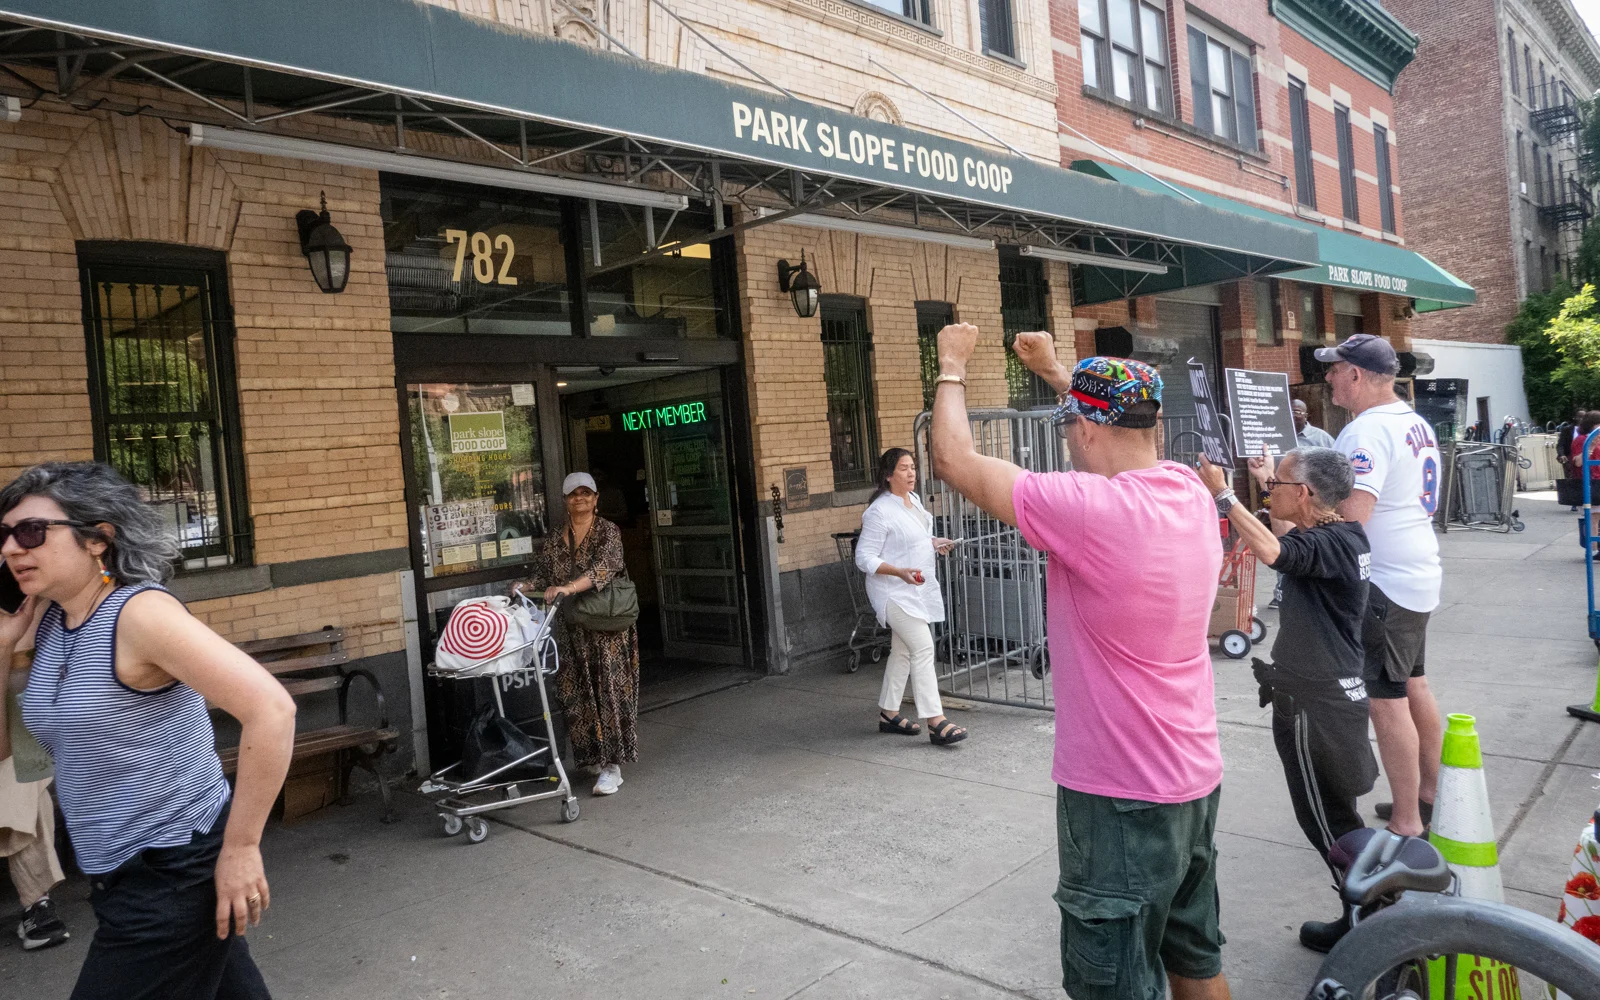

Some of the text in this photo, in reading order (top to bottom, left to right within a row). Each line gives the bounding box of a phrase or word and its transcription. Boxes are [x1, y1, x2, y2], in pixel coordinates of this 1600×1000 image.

[732, 102, 1013, 194] PARK SLOPE FOOD COOP
[446, 229, 518, 286] 782
[1328, 265, 1408, 292] PARK SLOPE FOOD COOP
[622, 409, 653, 431] NEXT
[655, 401, 707, 427] MEMBER
[452, 438, 504, 452] FOOD COOP
[453, 426, 502, 440] park slope
[1405, 422, 1440, 459] ZEIL
[448, 453, 512, 465] SHOPPING HOURS
[1419, 456, 1437, 516] 9
